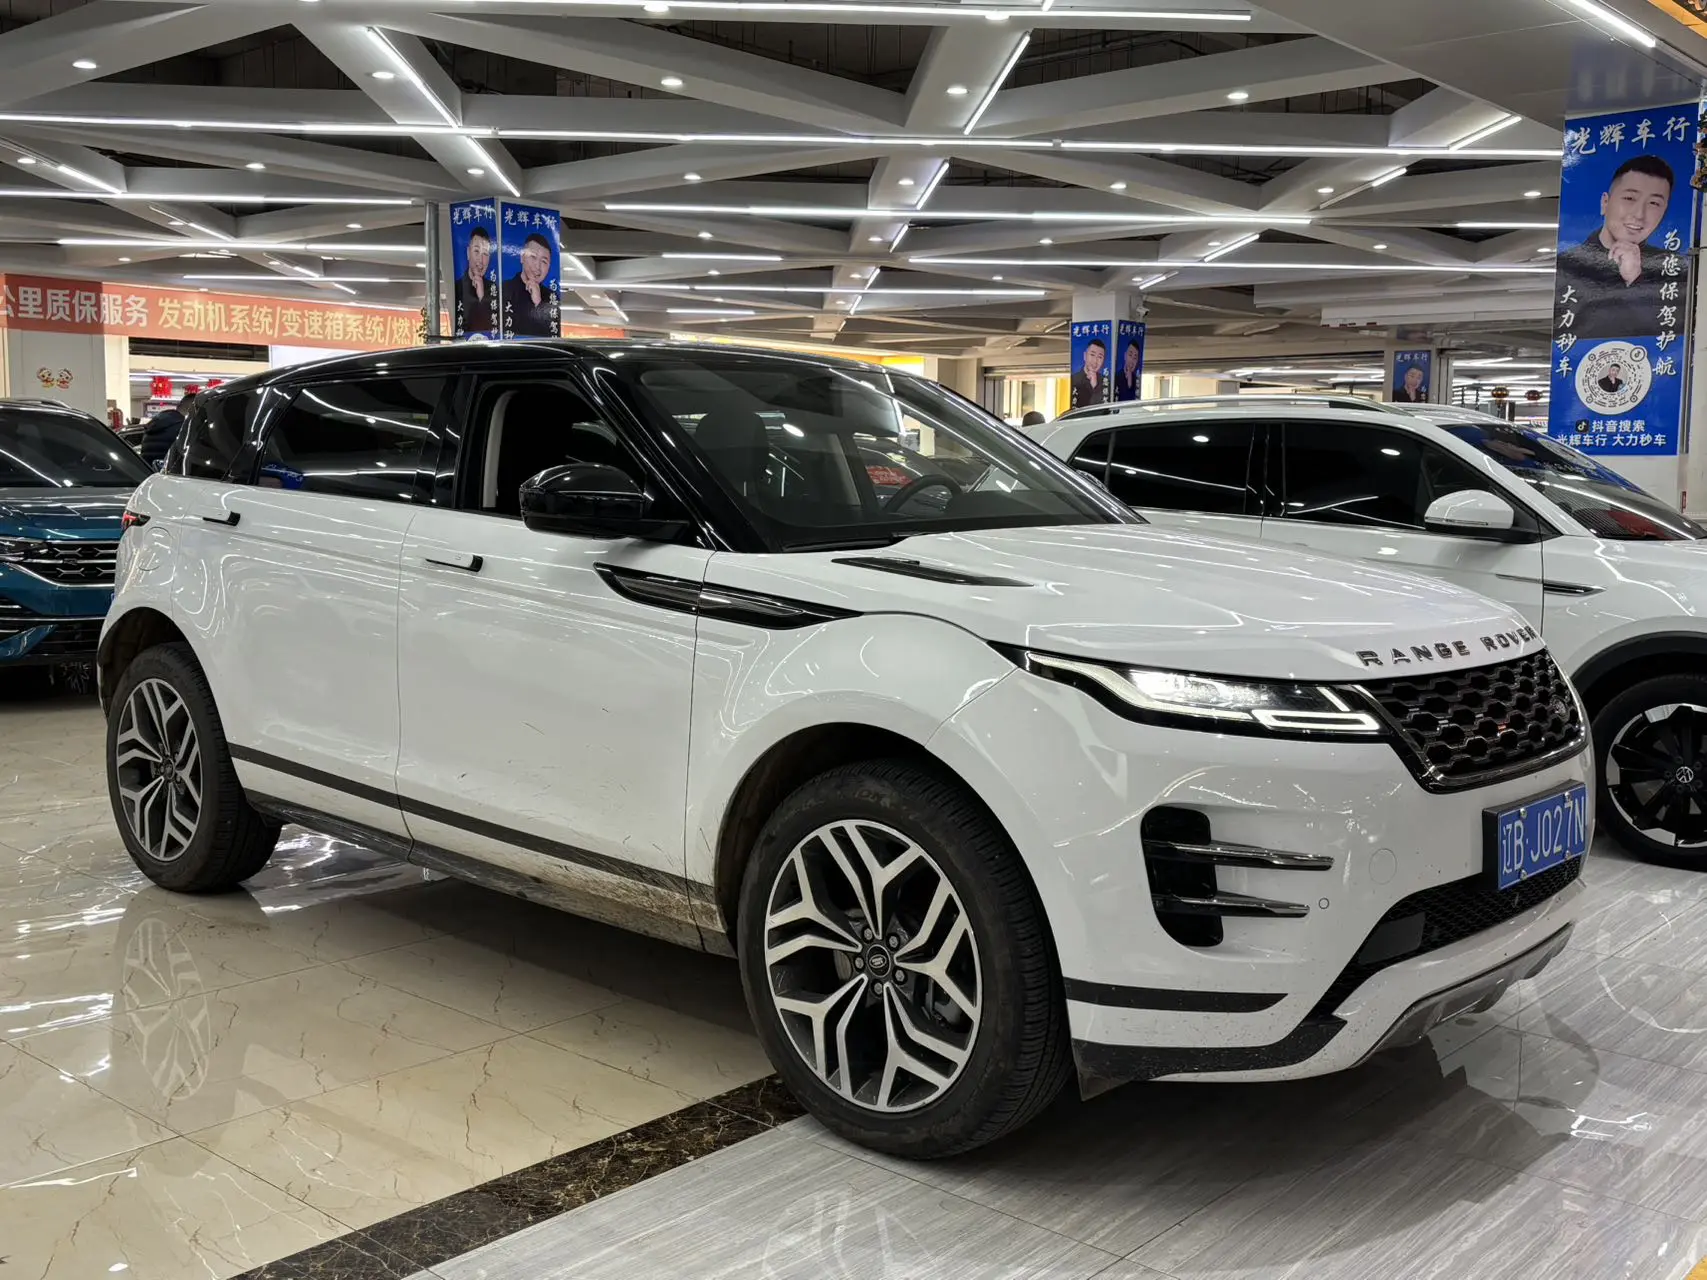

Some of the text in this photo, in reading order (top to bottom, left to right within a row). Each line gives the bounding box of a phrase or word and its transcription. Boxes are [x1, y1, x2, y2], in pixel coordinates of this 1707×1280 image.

[1571, 117, 1691, 155] 光辉车行
[549, 279, 559, 339] 为您保驾
[1652, 229, 1681, 376] 为您保驾护航
[1555, 285, 1578, 378] 大力秒车
[1558, 434, 1667, 447] 光辉车行 大力秒车
[1592, 420, 1646, 433] 抖音搜索
[1356, 625, 1537, 667] RANGE ROVER
